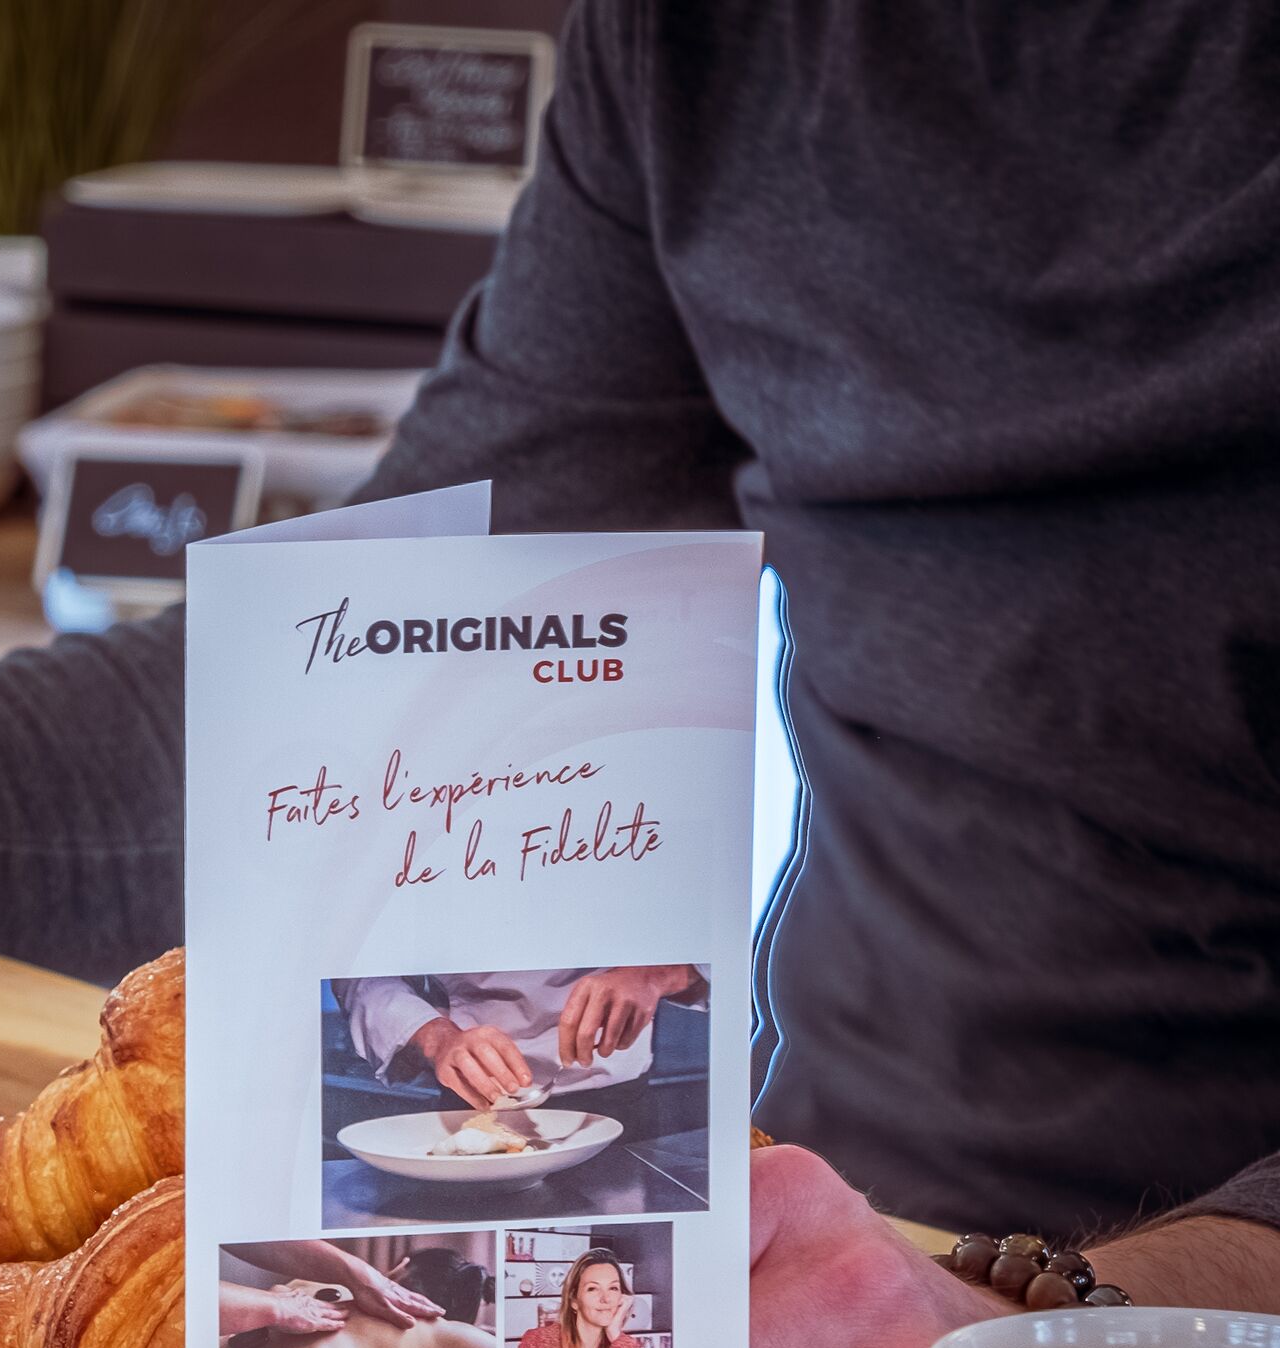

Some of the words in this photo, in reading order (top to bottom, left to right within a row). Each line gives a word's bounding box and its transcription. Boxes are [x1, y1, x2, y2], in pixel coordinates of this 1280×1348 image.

[532, 658, 624, 683] CLUB
[266, 766, 360, 841] Faites
[382, 749, 605, 832] l'expérience
[394, 830, 446, 887] de
[464, 820, 496, 882] la
[521, 801, 664, 881] Fidélité
